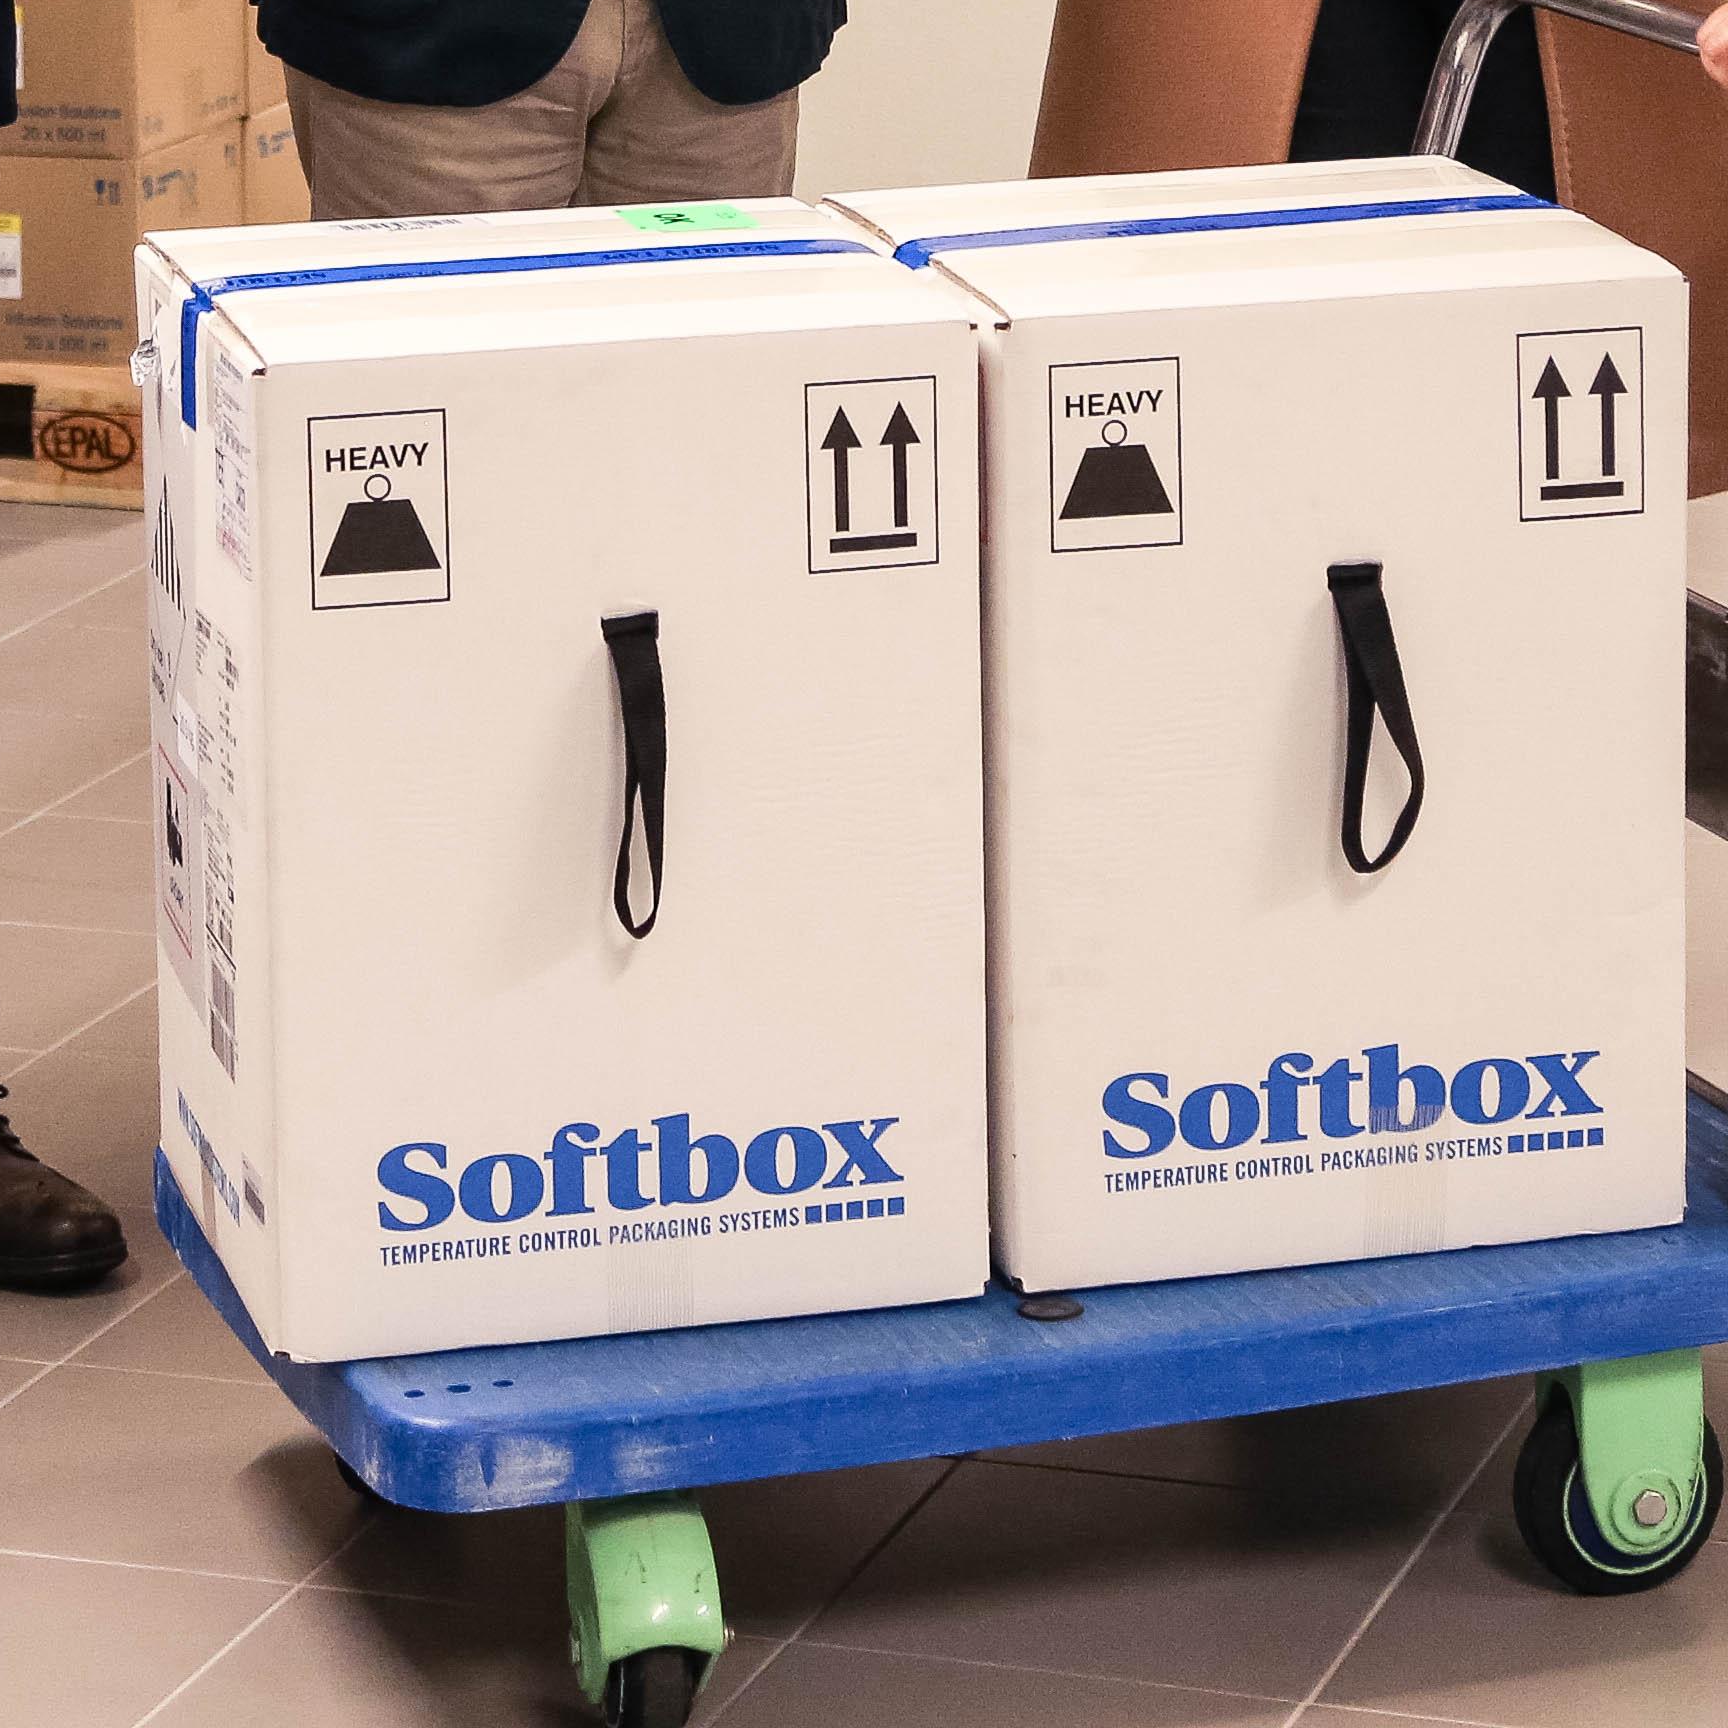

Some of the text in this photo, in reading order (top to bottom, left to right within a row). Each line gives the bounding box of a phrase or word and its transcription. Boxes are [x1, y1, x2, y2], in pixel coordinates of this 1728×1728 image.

[1065, 389, 1163, 419] HEAVY
[54, 425, 120, 460] EPAL
[324, 441, 429, 473] HEAVY
[1102, 1044, 1604, 1159] Softbox
[377, 1112, 905, 1232] Softbox
[1105, 1136, 1503, 1193] TEMPERATURE CONTROL PACKAGING SYSTEMS
[380, 1207, 801, 1267] TEMPERATURE CONTROL PACKAGING SYSTEMS
